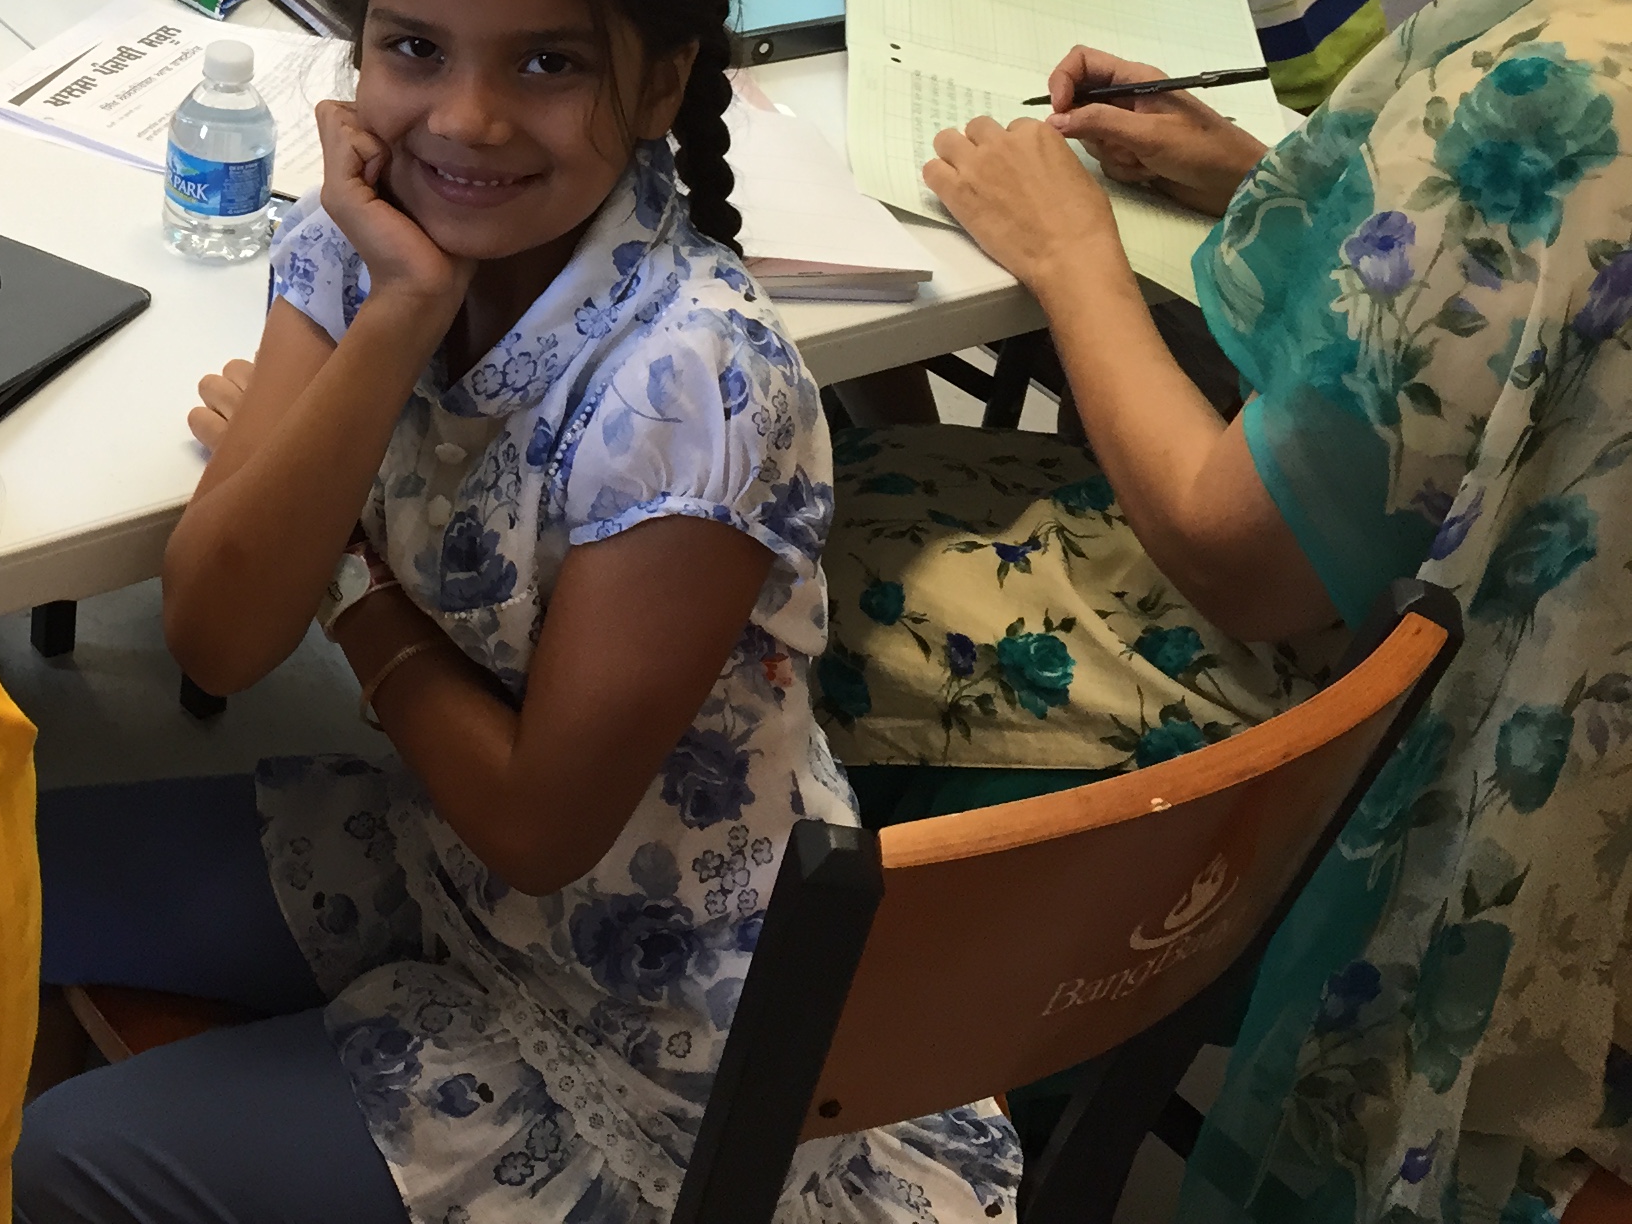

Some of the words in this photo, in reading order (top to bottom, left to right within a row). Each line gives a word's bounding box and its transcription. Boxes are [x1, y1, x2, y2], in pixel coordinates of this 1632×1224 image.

[43, 76, 98, 108] ਖਾਲਸਾ
[91, 45, 146, 77] ਪੰਜਾਬੀ
[136, 24, 183, 47] ਸਕੂਲ
[173, 175, 209, 202] PARK
